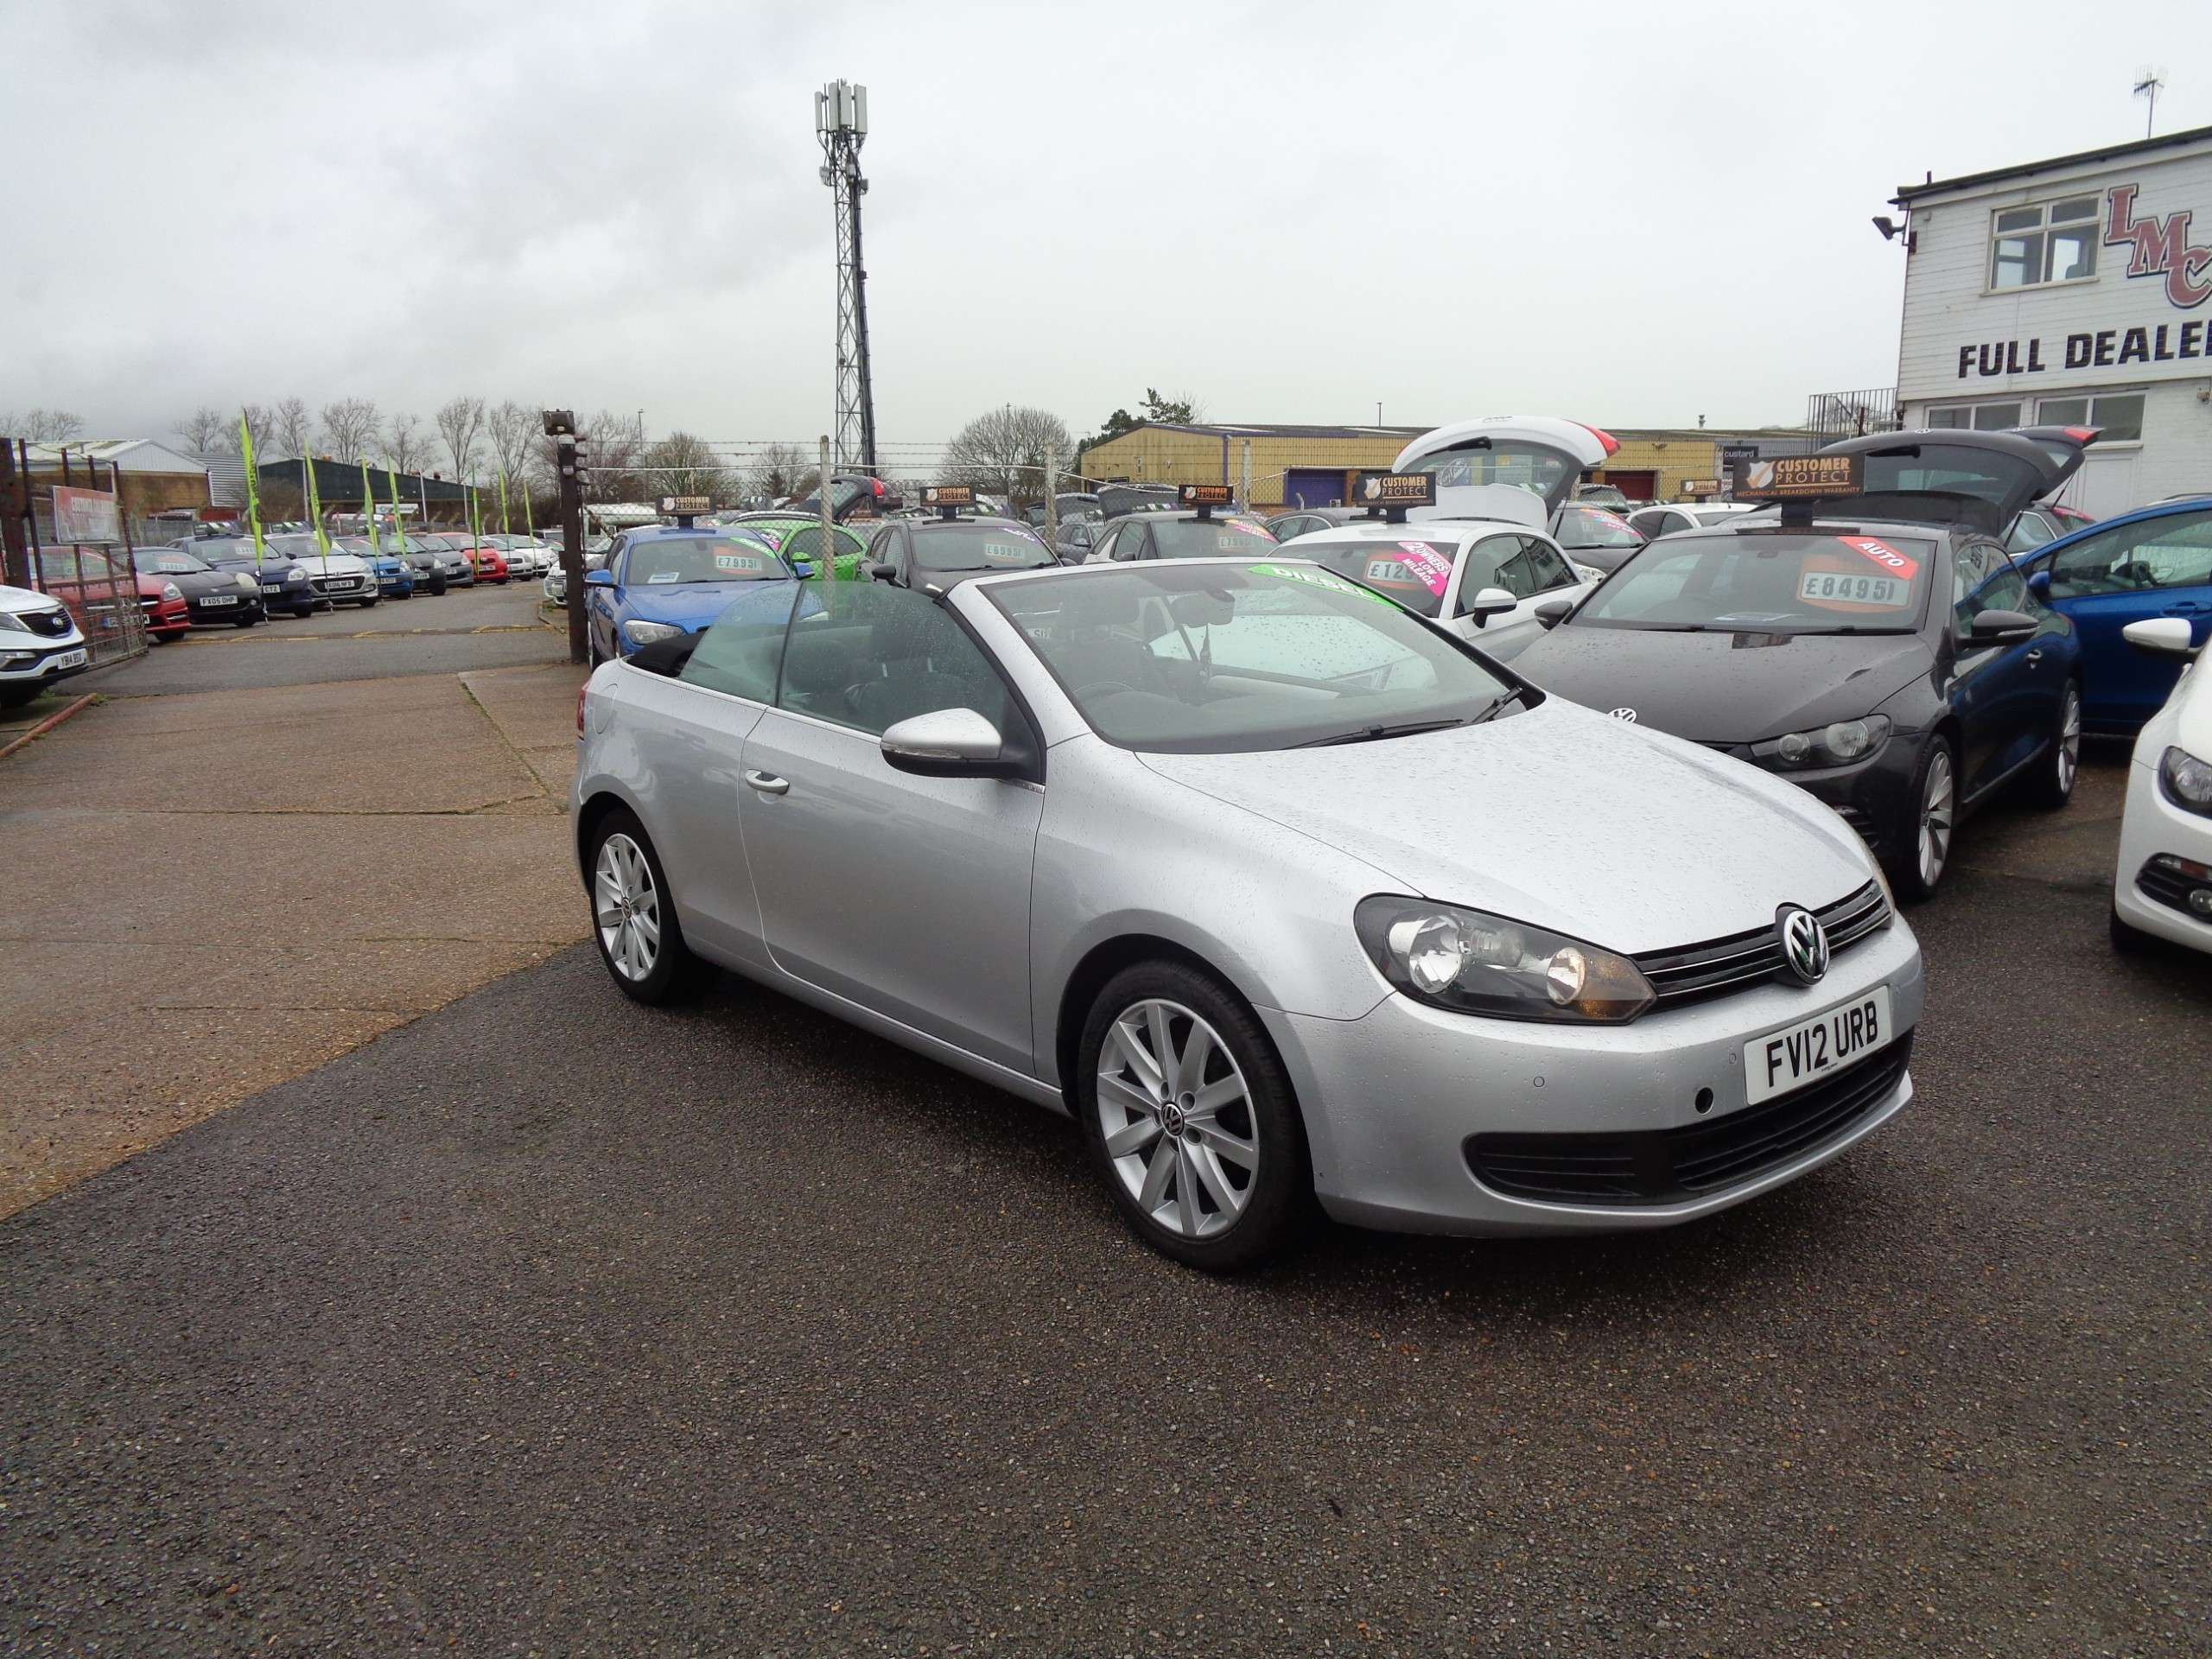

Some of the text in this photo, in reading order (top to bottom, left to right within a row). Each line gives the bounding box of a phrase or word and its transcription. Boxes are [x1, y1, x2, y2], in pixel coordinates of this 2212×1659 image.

[2104, 183, 2212, 308] LMC
[1958, 338, 2046, 379] FULL
[1776, 469, 1851, 485] PROTECT
[1777, 457, 1851, 474] CUSTOMER
[1382, 475, 1427, 487] CUSTOMER
[1382, 486, 1427, 496] PROTECT
[1736, 489, 1779, 499] MECHANICAL
[1418, 547, 1449, 573] OWNERS
[1420, 561, 1438, 575] LOW
[1857, 542, 1904, 568] AUTO
[1271, 567, 1376, 601] DIESEL
[1402, 558, 1437, 587] MILEAGE
[1766, 1001, 1878, 1088] FV12 URB
